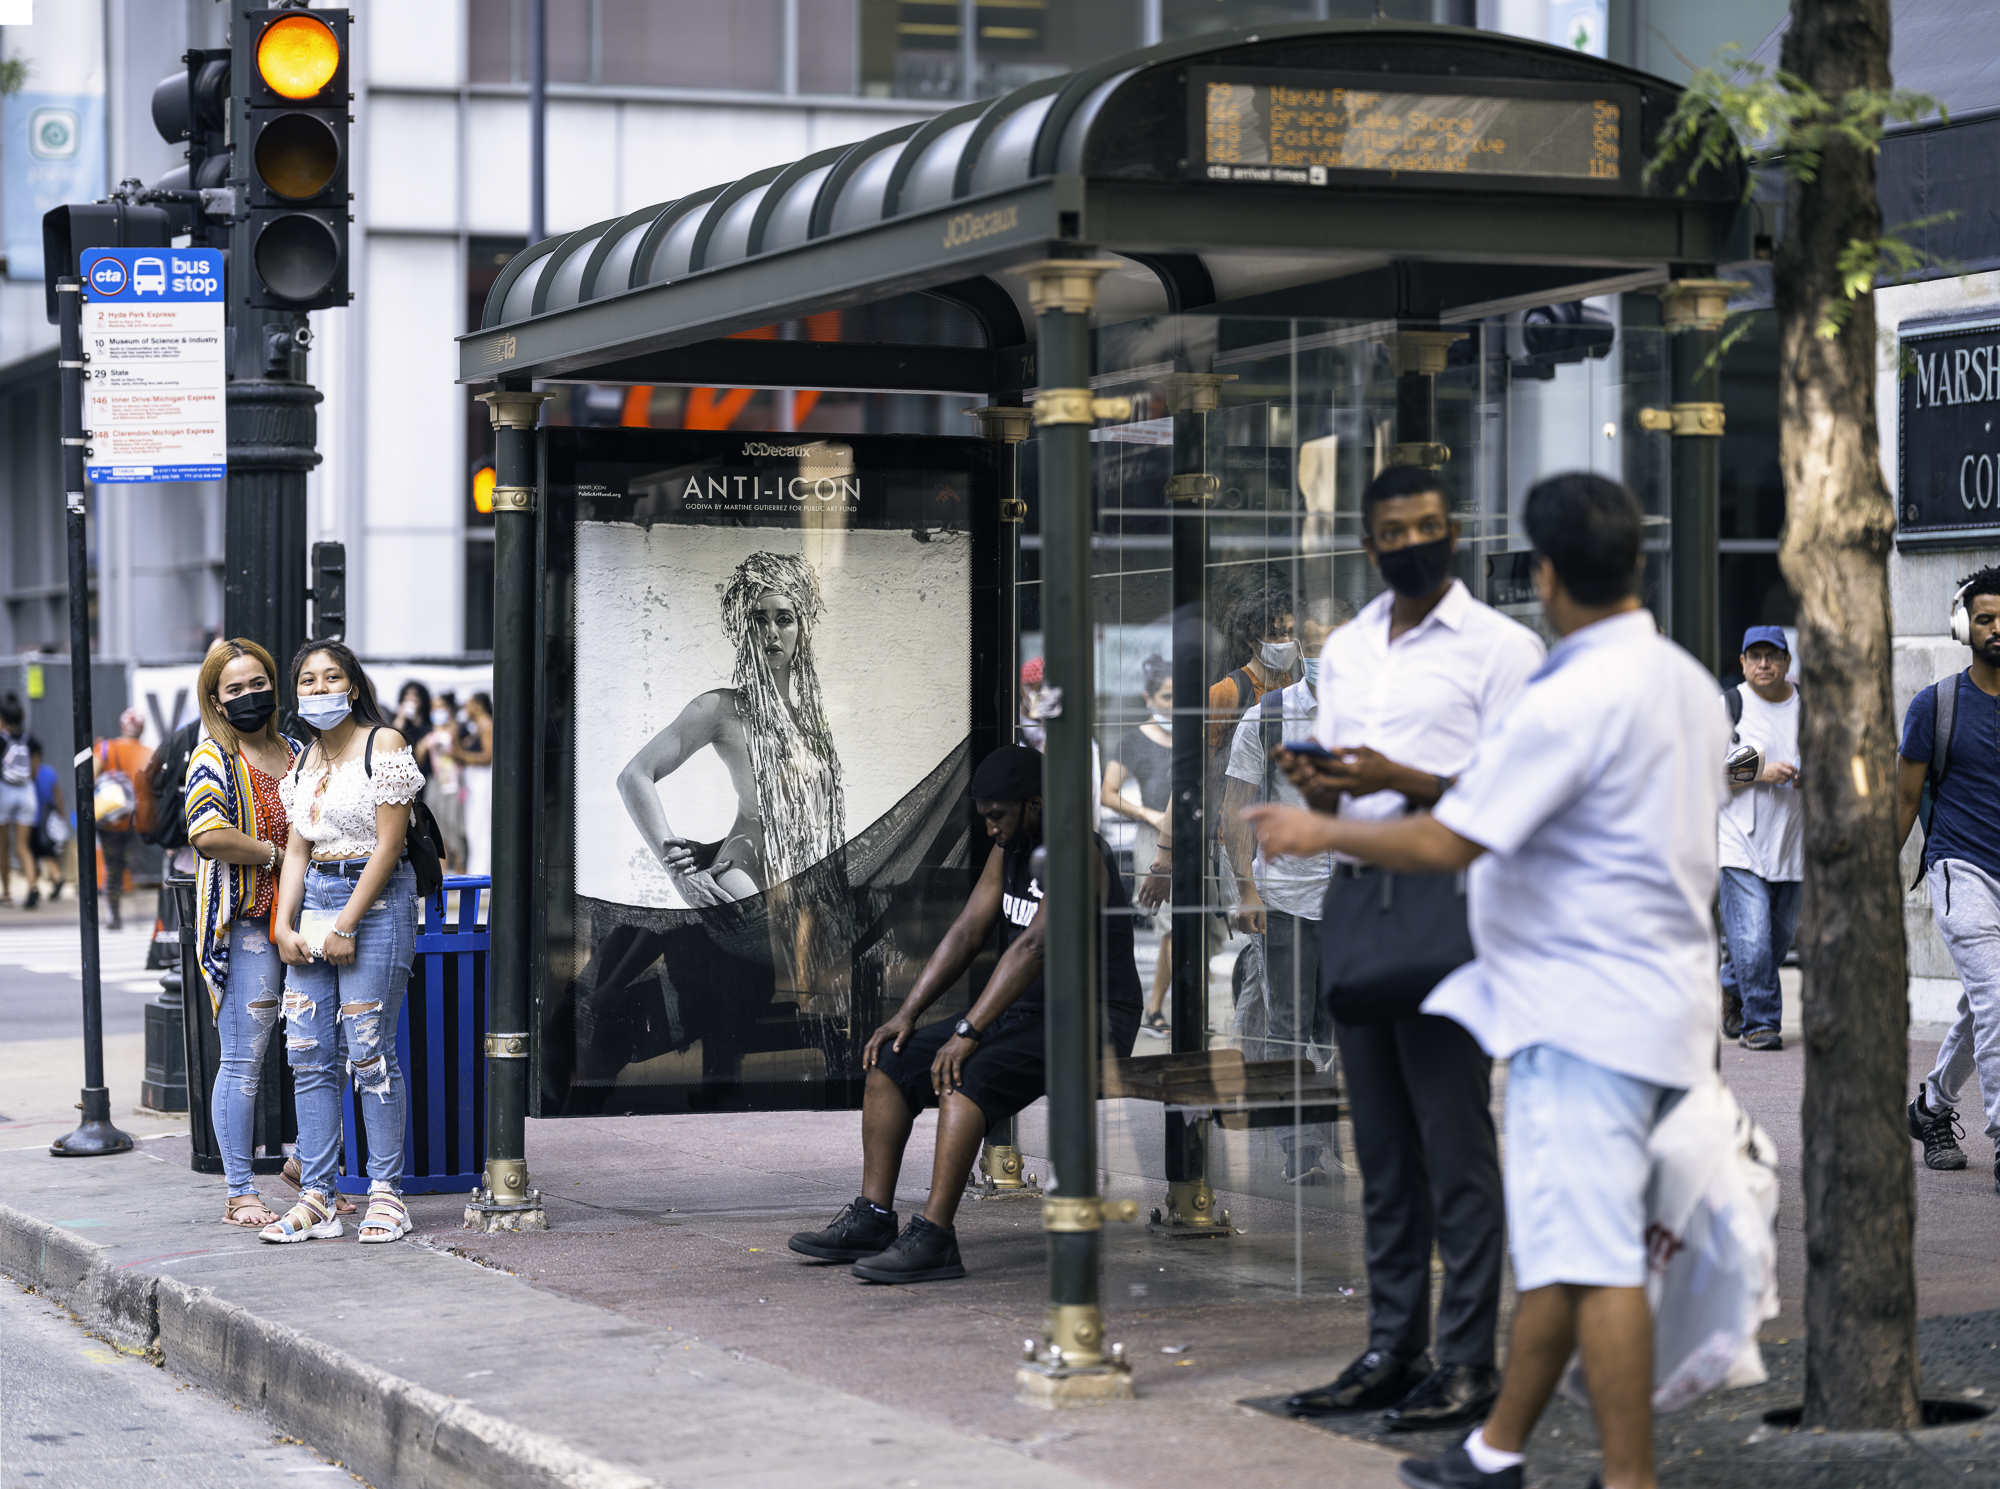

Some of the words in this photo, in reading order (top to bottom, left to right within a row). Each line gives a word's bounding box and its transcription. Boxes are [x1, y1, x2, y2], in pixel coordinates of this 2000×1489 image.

[1206, 82, 1233, 103] 29
[1270, 85, 1326, 107] Navy
[1331, 87, 1383, 109] Pier
[1408, 110, 1475, 133] Shore
[1270, 124, 1438, 151] Foster/Marine
[1445, 131, 1507, 154] Drive
[1206, 164, 1232, 179] cta
[1232, 166, 1271, 180] arrival
[1273, 168, 1308, 182] times
[943, 203, 1019, 250] JCDecaux
[171, 257, 210, 274] bus
[95, 270, 122, 282] cta
[172, 276, 218, 296] stop
[98, 312, 104, 320] 2
[108, 312, 127, 320] Hyde
[95, 370, 106, 378] 29
[1021, 354, 1035, 380] 74
[187, 394, 216, 402] Express
[186, 428, 215, 436] Express
[742, 442, 811, 457] JCDecaux
[682, 475, 861, 501] ANTI-ICON
[1960, 453, 2000, 511] CO
[724, 503, 752, 511] MARTINE
[754, 504, 787, 512] GUTIERREZ
